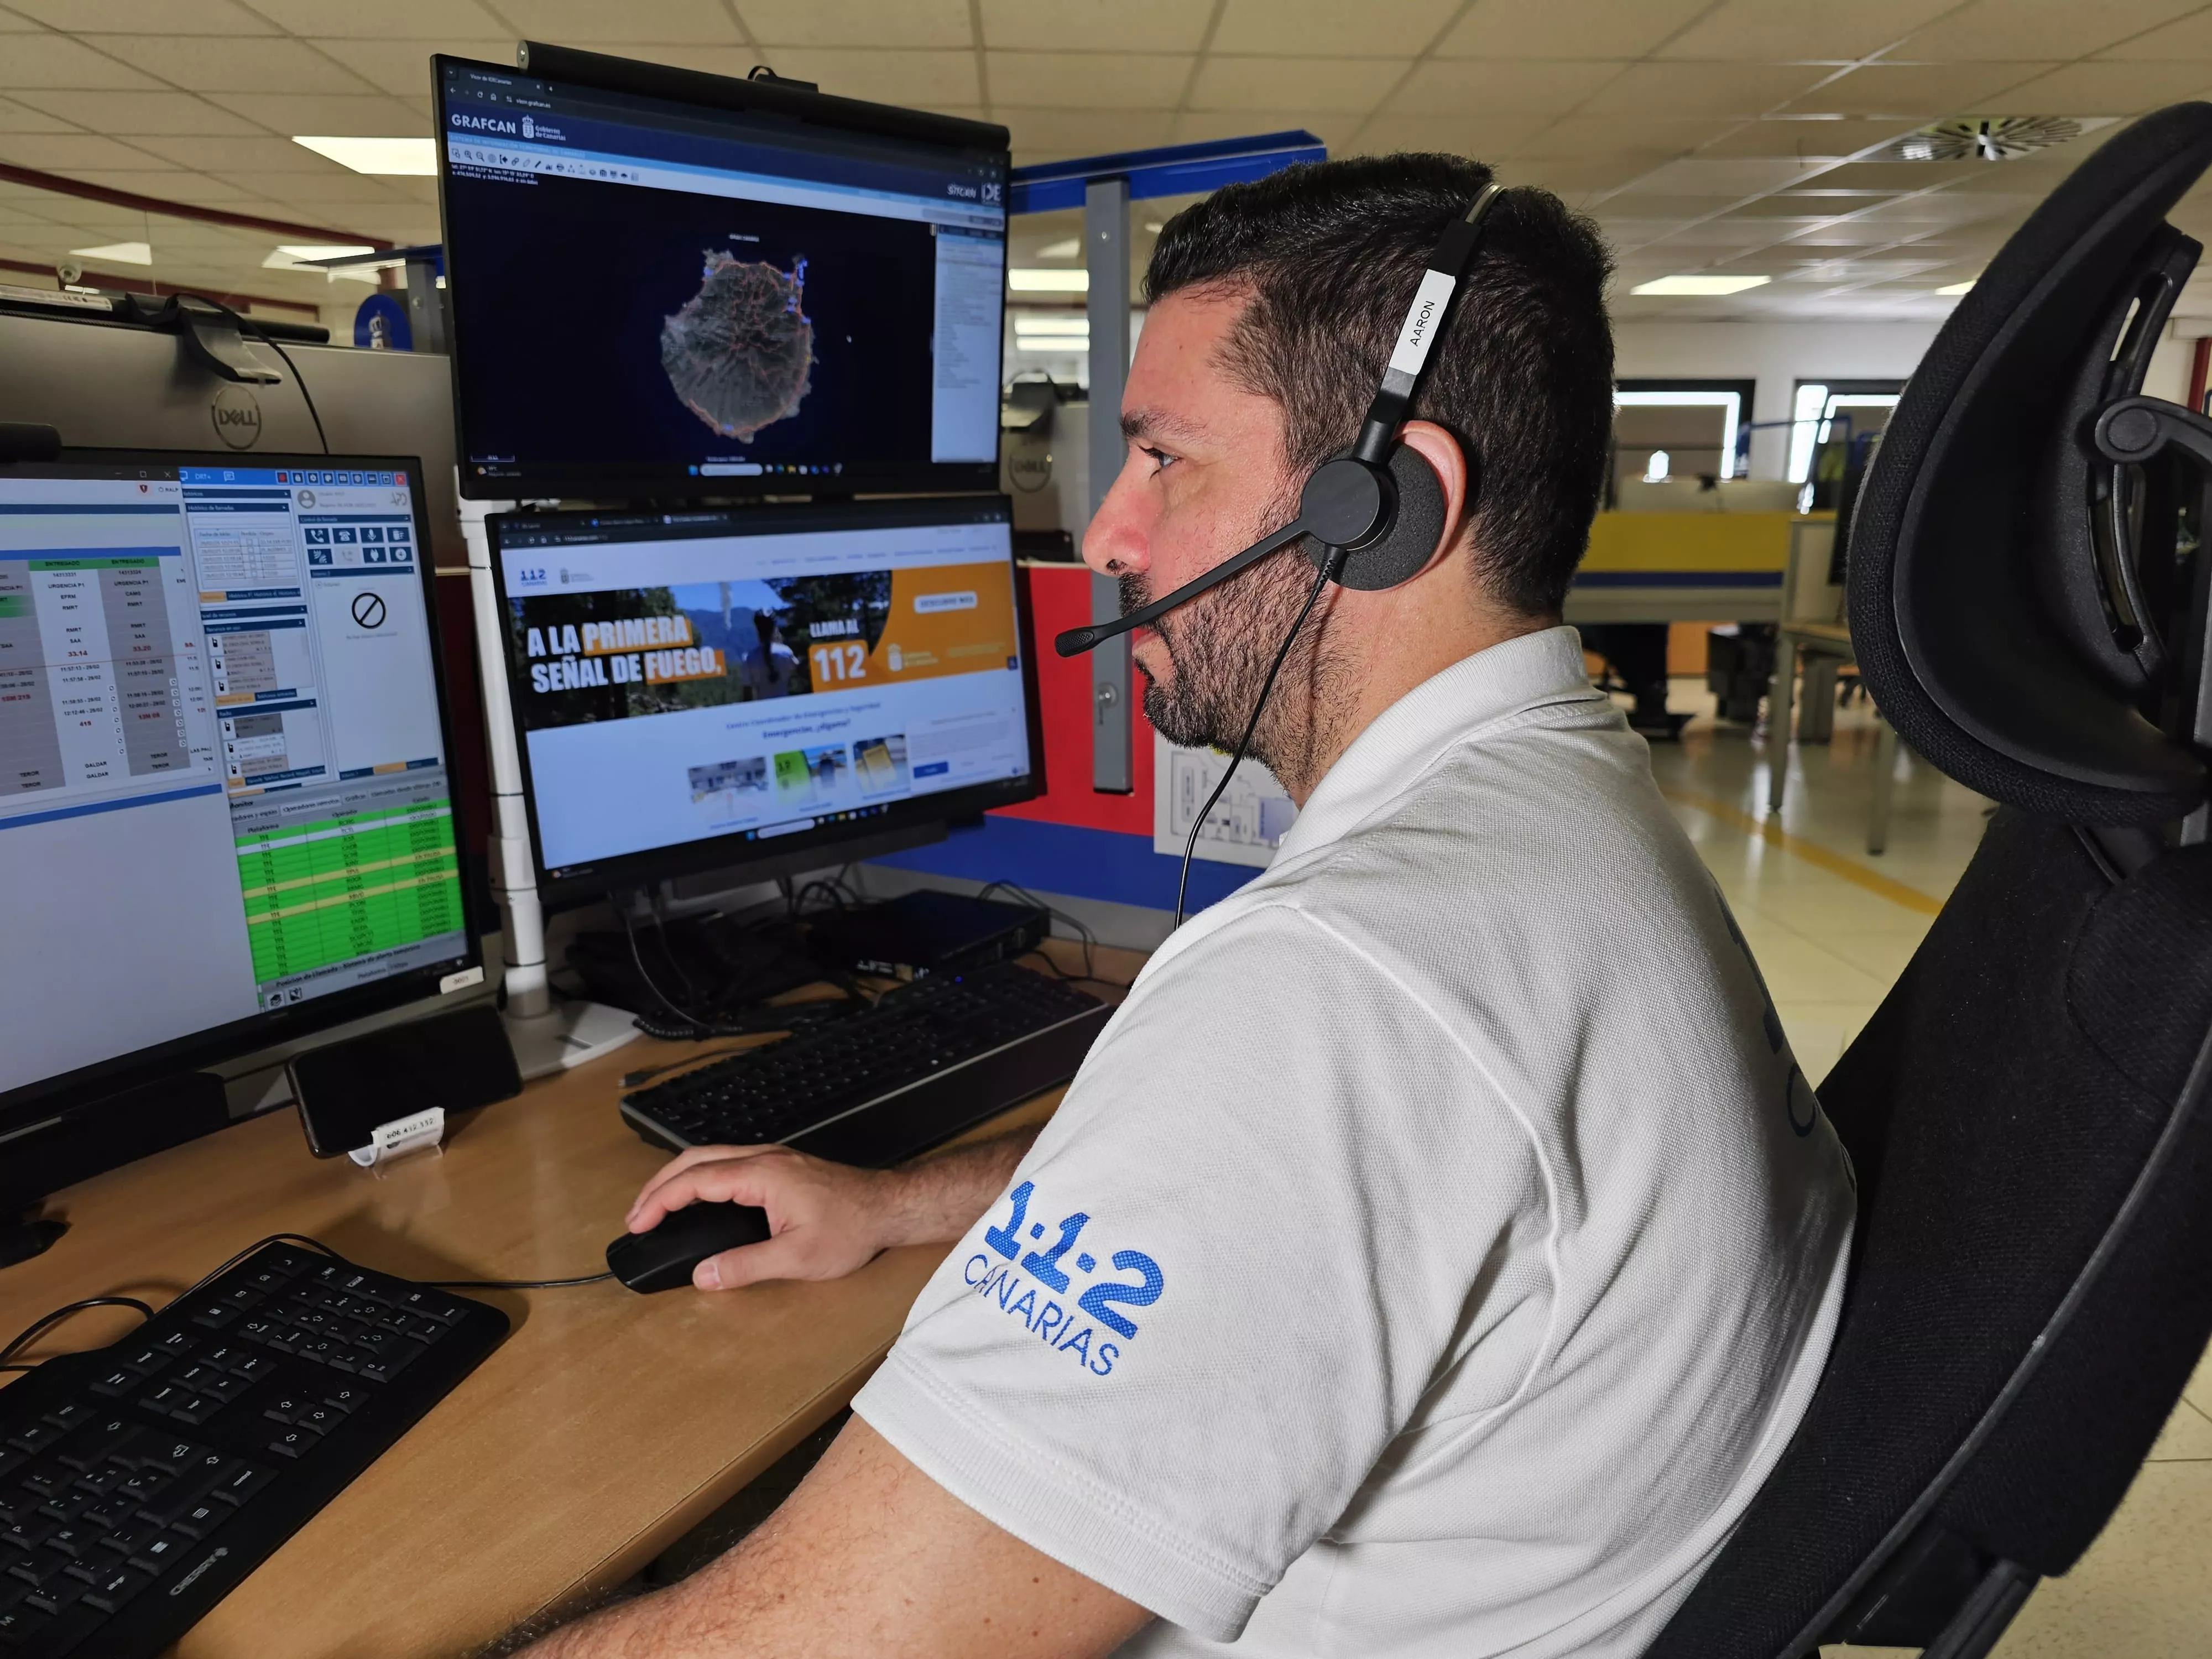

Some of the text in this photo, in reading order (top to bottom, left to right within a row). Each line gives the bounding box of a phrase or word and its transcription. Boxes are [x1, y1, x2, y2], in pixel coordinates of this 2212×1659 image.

[451, 113, 516, 134] GRAFCAN
[535, 125, 561, 134] Gobierno
[543, 133, 566, 142] Canarias
[1410, 300, 1435, 347] AARON
[218, 409, 258, 426] DELL
[521, 568, 546, 581] 112
[527, 615, 690, 658] A LA PRIMERA
[809, 618, 860, 638] LLAMA AL
[530, 654, 609, 693] SEÑAL
[611, 653, 643, 684] DE
[813, 644, 867, 682] 112
[964, 1254, 1120, 1376] CANARIAS
